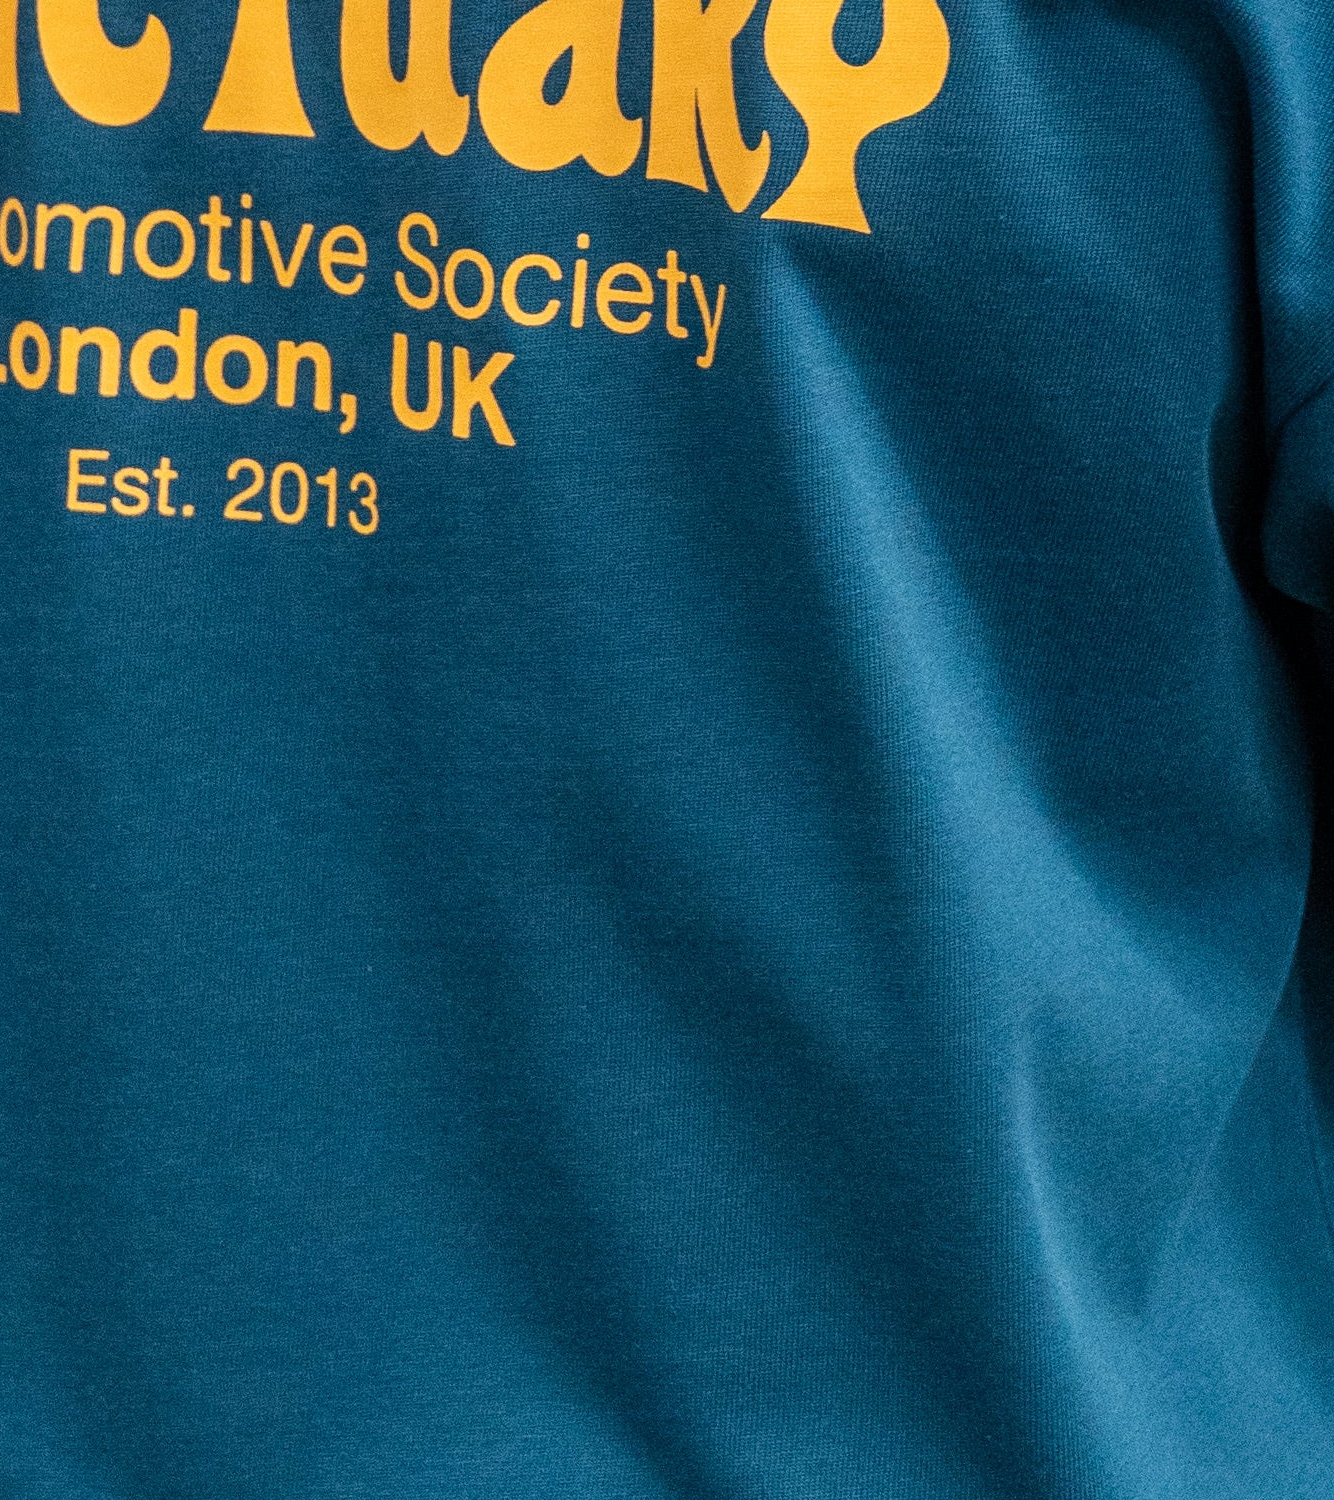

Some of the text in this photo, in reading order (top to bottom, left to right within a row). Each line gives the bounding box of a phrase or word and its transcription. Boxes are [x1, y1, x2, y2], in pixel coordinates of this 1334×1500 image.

[394, 211, 727, 369] Society
[390, 332, 516, 447] UK
[66, 448, 380, 535] Est. 2013
